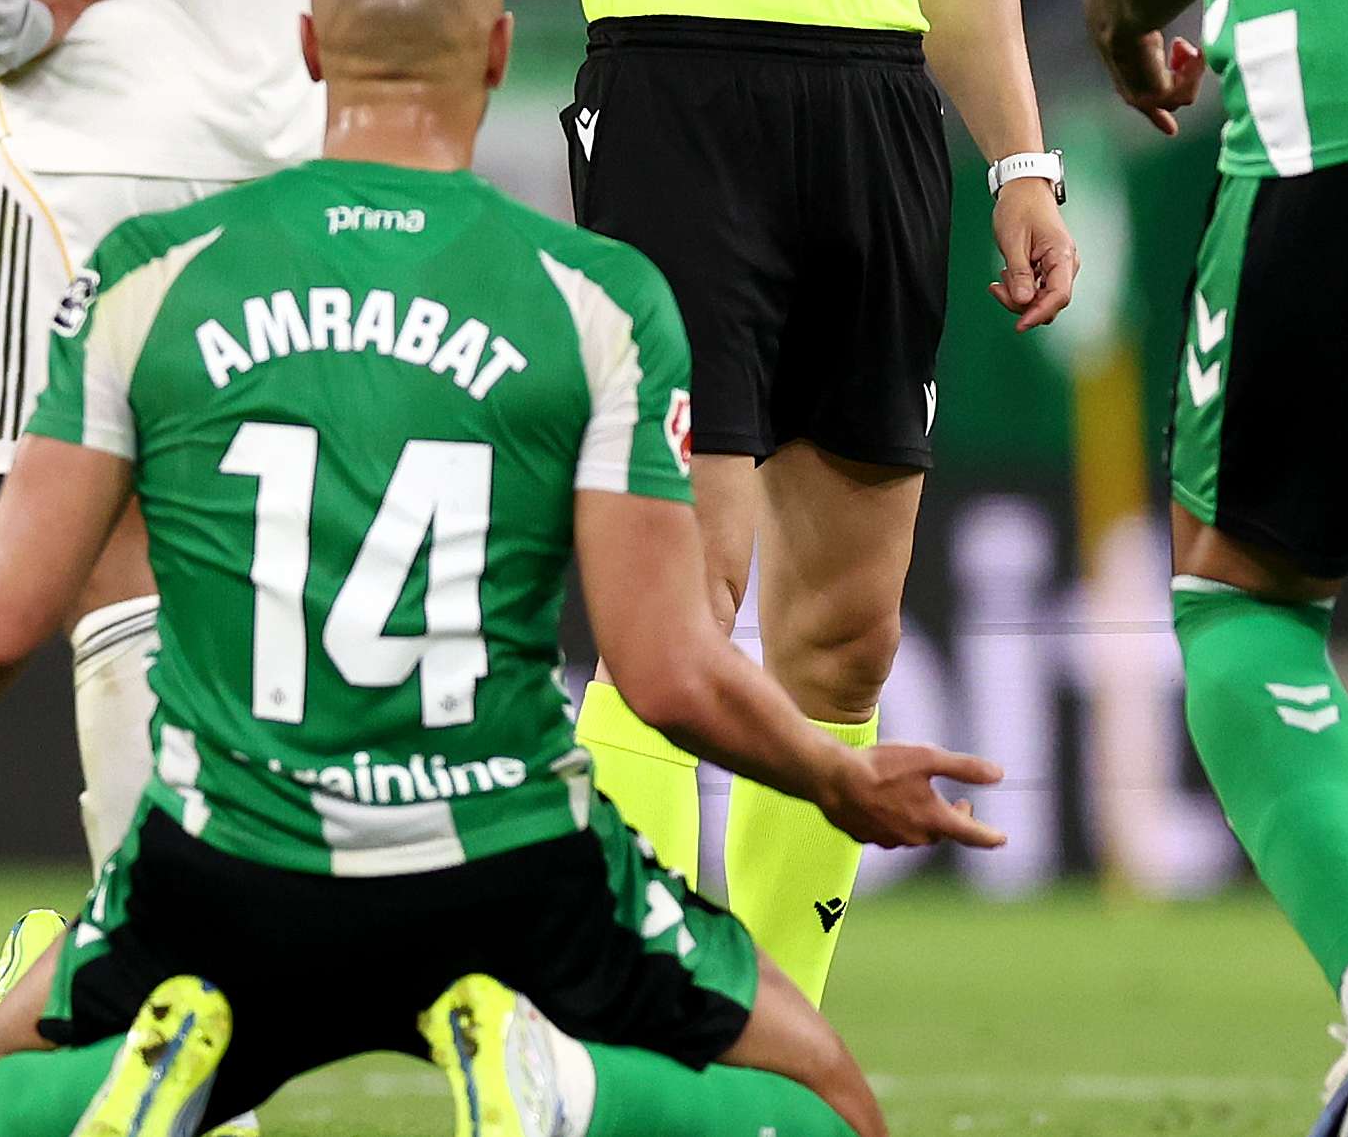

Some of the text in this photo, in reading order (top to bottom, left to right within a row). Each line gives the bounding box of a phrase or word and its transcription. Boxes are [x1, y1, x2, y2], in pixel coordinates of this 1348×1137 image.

[325, 205, 425, 235] prima
[195, 287, 528, 401] AMRABAT
[219, 421, 494, 729] 14
